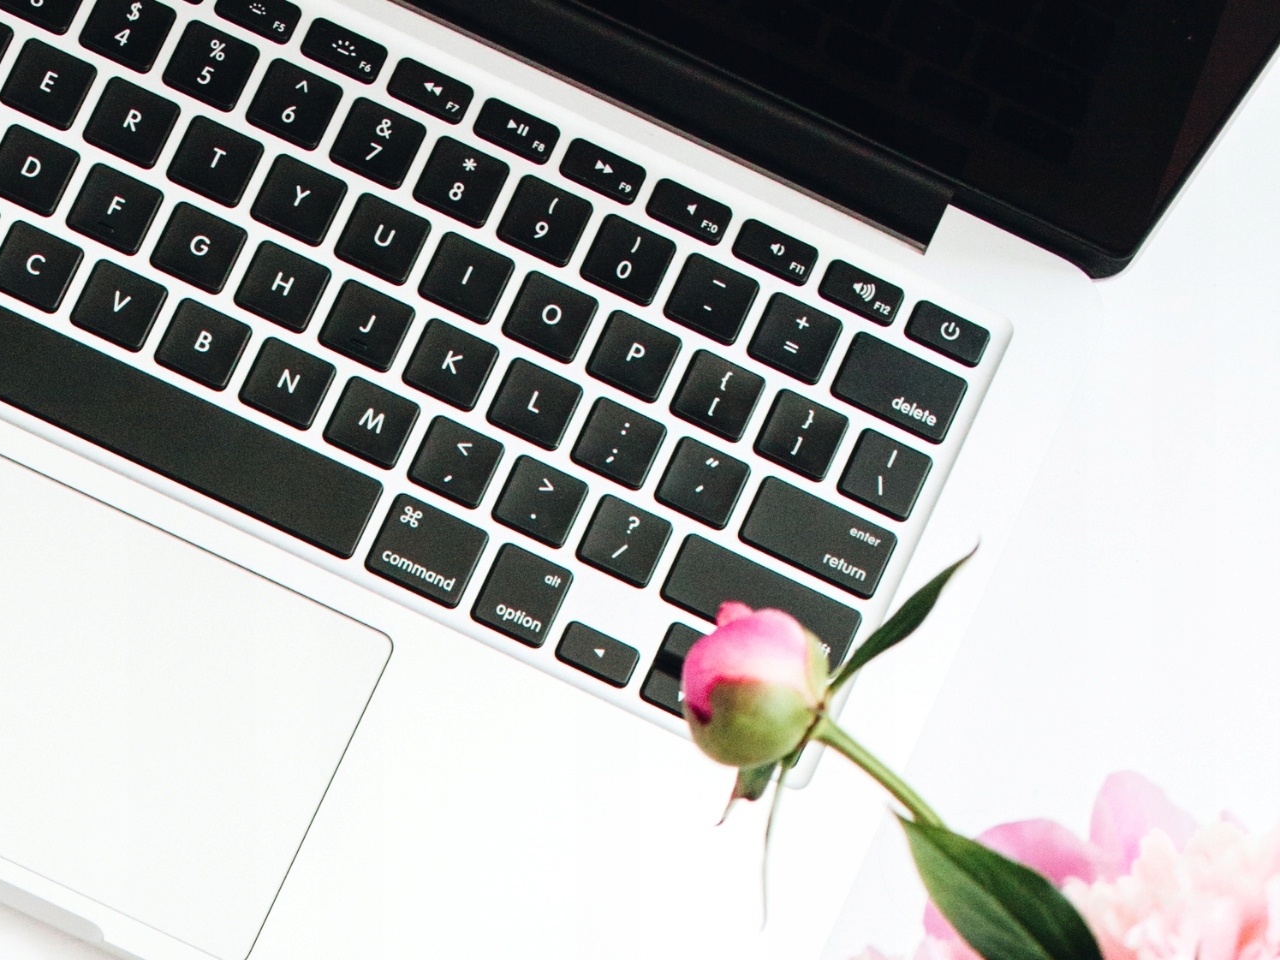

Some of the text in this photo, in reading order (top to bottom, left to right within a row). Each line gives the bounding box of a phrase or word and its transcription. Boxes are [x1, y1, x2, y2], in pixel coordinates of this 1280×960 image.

[126, 1, 143, 21] $
[272, 20, 286, 32] F5
[114, 28, 131, 47] 4
[209, 39, 226, 61] %
[196, 66, 215, 85] 5
[358, 60, 372, 73] F6
[39, 70, 59, 93] E
[281, 105, 297, 123] 6
[445, 101, 460, 113] F7
[122, 108, 142, 132] R
[375, 118, 393, 140] &
[365, 142, 383, 161] 7
[531, 140, 546, 152] F8
[20, 155, 42, 178] D
[210, 147, 227, 169] T
[293, 184, 311, 207] Y
[448, 182, 465, 201] 8
[618, 181, 632, 193] F9
[106, 195, 126, 215] F
[373, 224, 396, 247] U
[533, 221, 549, 239] 9
[189, 235, 211, 256] G
[26, 254, 46, 276] C
[616, 260, 633, 279] 0
[789, 261, 806, 275] F11
[271, 271, 295, 296] H
[113, 290, 132, 313] V
[873, 300, 891, 316] F12
[358, 314, 377, 333] J
[541, 304, 562, 325] O
[193, 330, 213, 353] B
[625, 342, 646, 362] P
[441, 350, 464, 375] K
[276, 368, 301, 394] N
[527, 390, 540, 414] L
[891, 395, 937, 427] delete
[357, 407, 385, 434] M
[626, 515, 641, 535] ?
[849, 525, 882, 547] enter
[381, 546, 456, 592] command
[822, 553, 867, 582] return
[544, 572, 562, 588] alt
[495, 601, 542, 633] option
